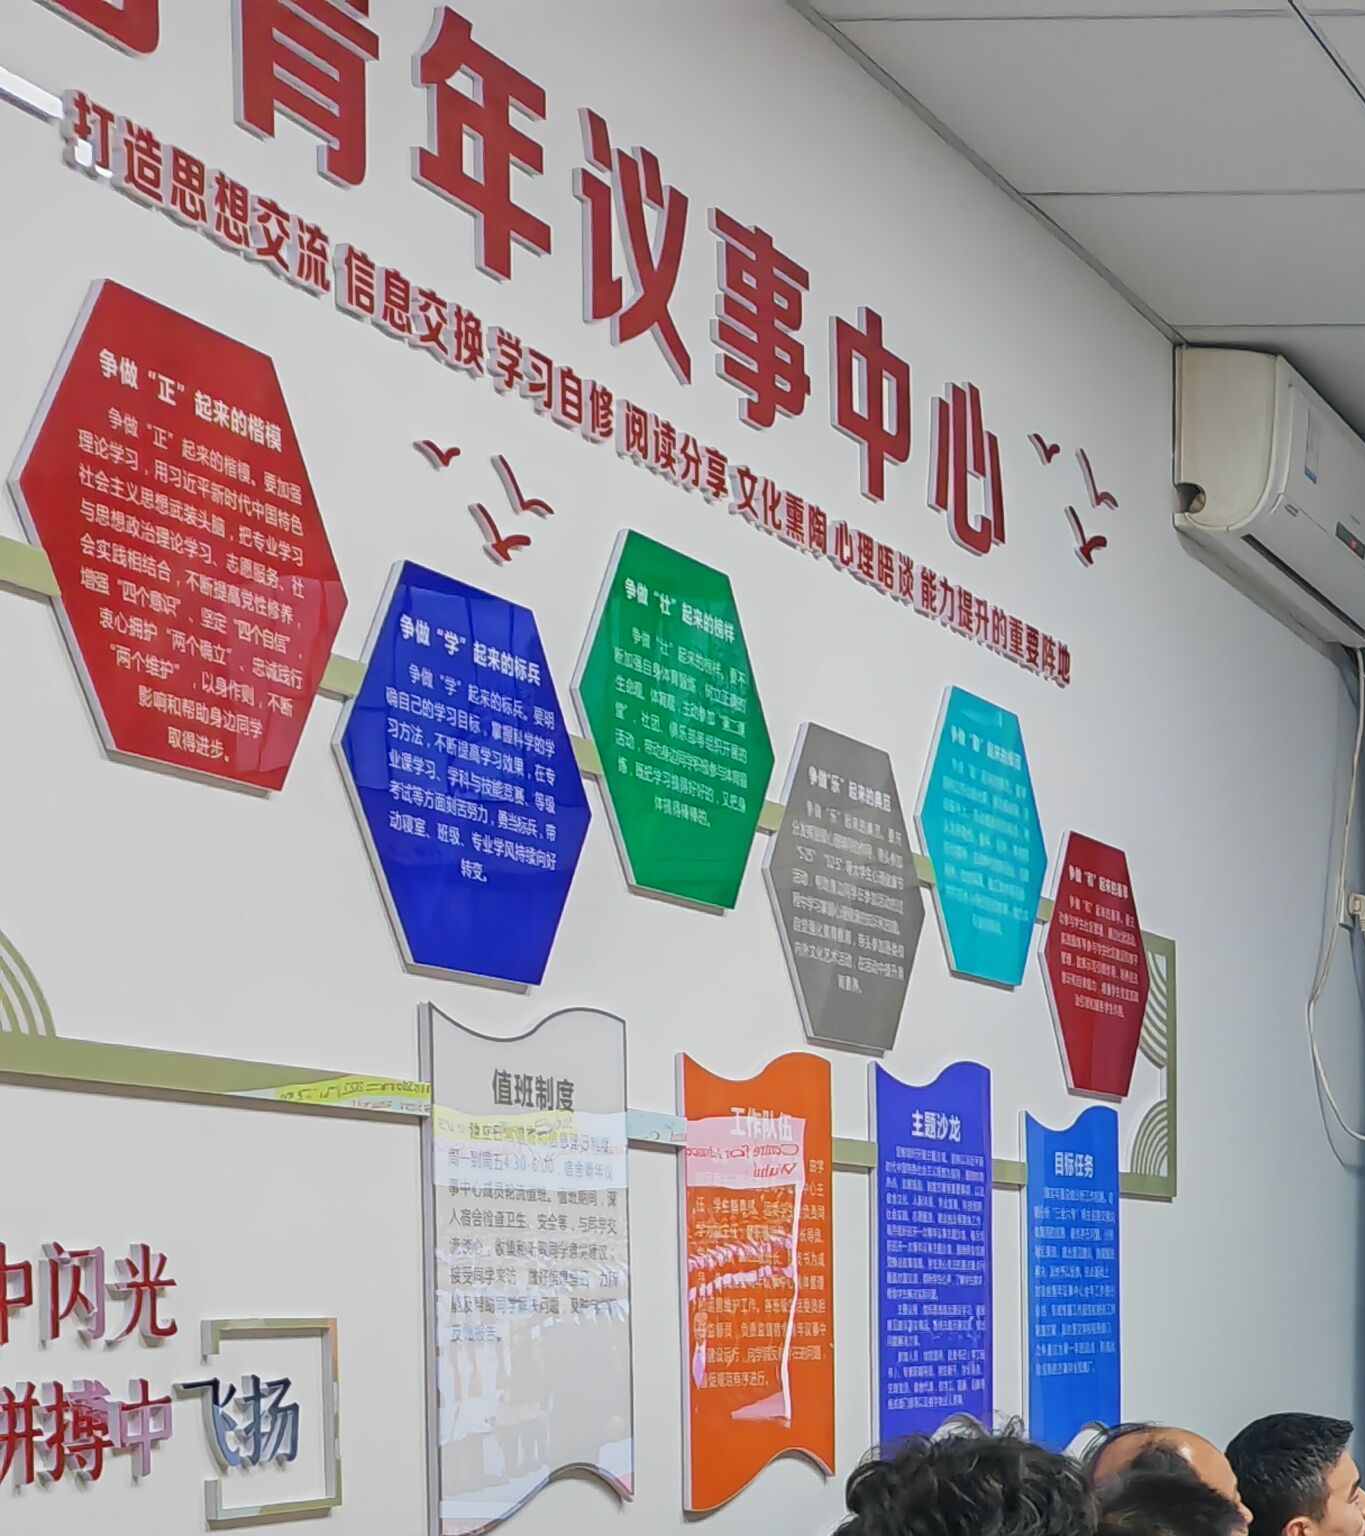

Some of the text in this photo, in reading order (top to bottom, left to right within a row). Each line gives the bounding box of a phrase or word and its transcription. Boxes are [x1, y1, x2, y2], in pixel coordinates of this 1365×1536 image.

[0, 0, 1007, 557] 青年议事中心
[68, 90, 1071, 687] 打造思想交流 信息交换 学习自修 阅读分享 文化熏陶 心理晤谈 能力提升的重要阵地
[492, 1068, 575, 1112] 值班制度
[911, 1109, 961, 1143] 主题沙龙
[1054, 1151, 1094, 1178] 目标任务
